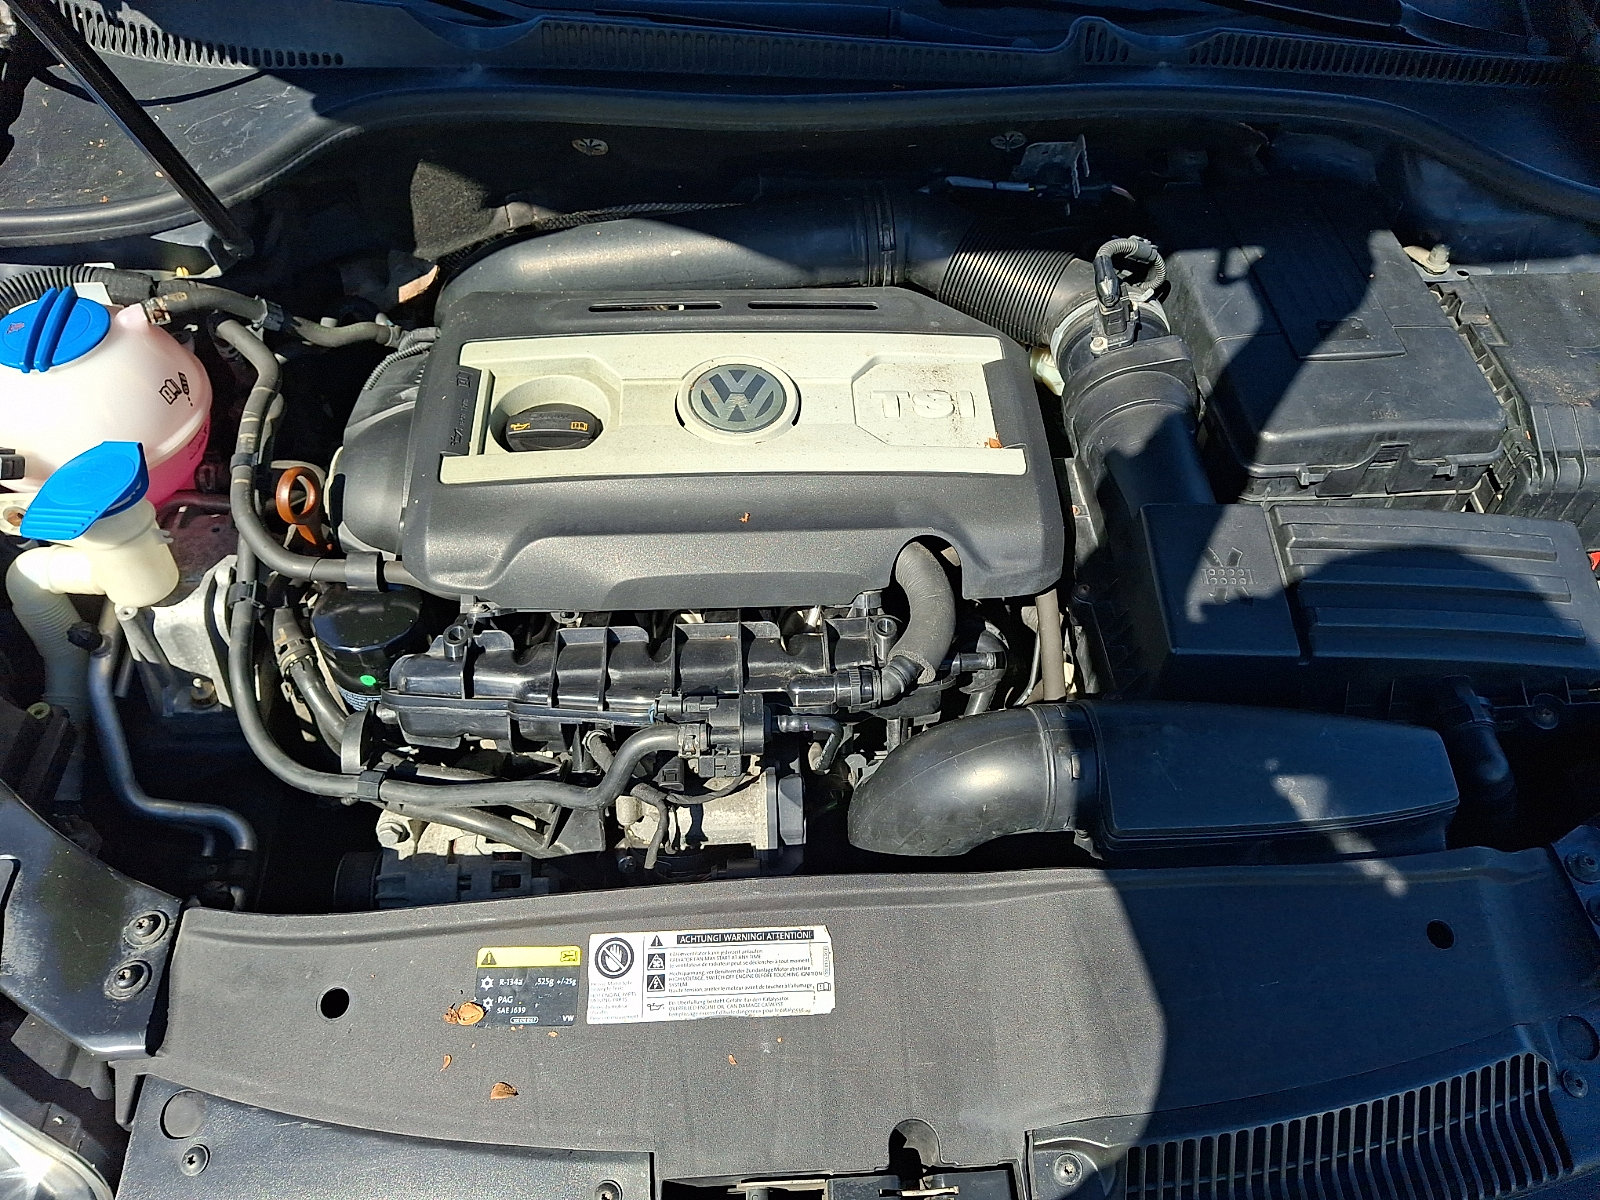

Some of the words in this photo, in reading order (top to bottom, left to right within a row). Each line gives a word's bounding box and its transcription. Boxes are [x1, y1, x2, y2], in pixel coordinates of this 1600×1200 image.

[691, 364, 786, 432] VW
[871, 390, 976, 419] TSI
[680, 933, 721, 943] ACHTUNG!
[723, 932, 764, 941] WARNING!
[766, 930, 810, 940] ATTENTION!
[497, 995, 513, 1003] PAG
